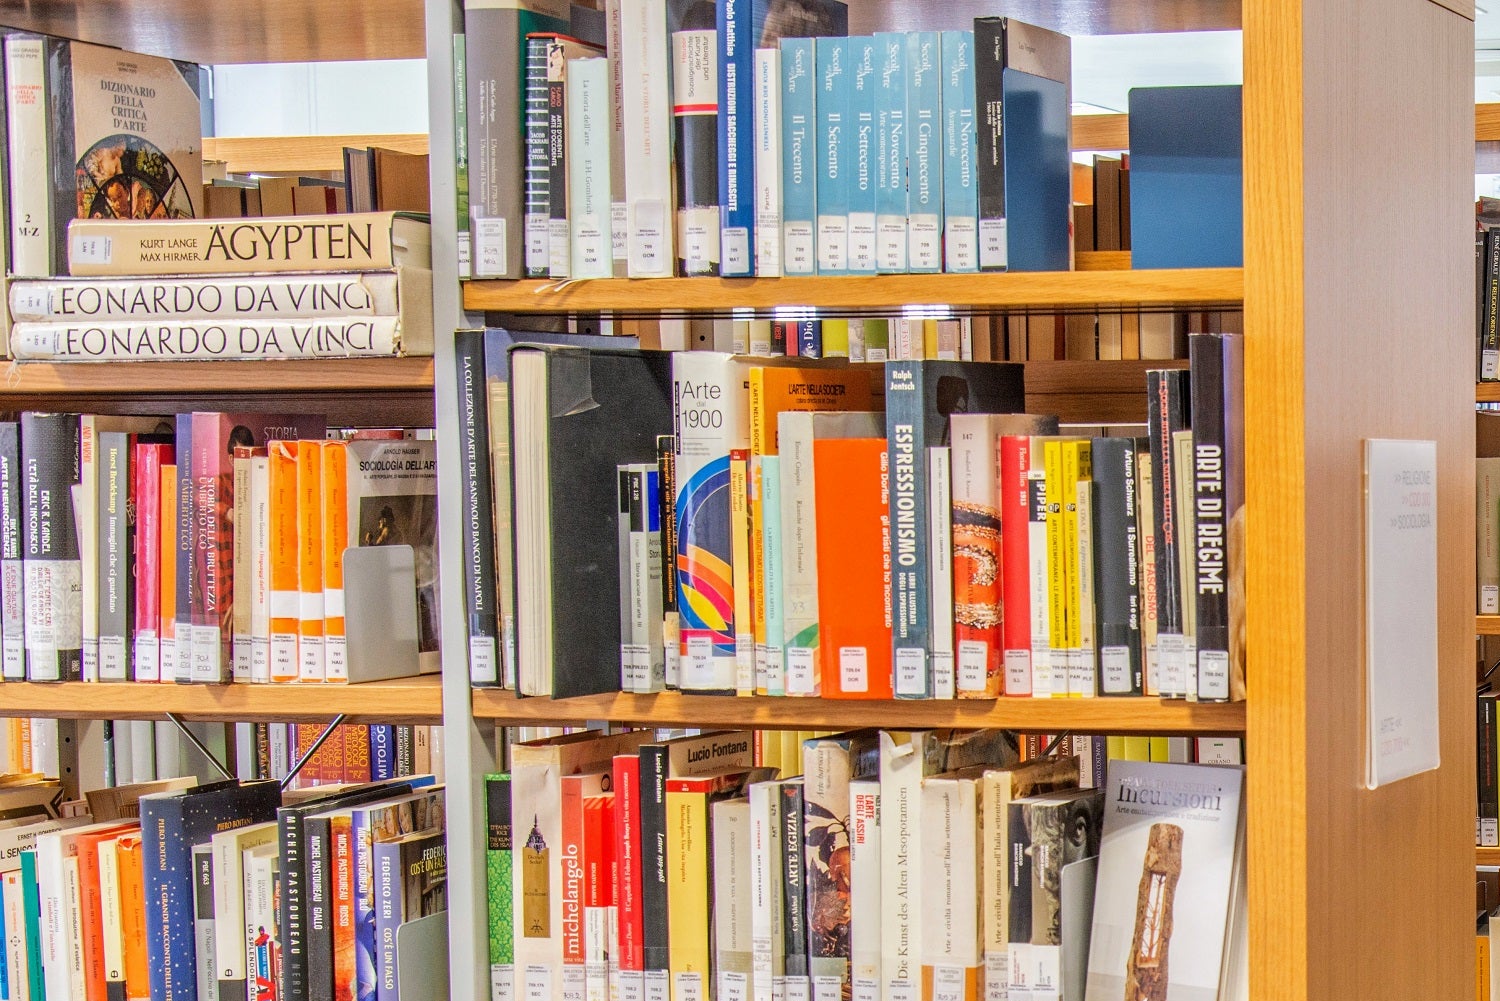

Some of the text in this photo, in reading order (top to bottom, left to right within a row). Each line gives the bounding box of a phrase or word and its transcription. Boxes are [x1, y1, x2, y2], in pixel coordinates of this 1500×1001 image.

[100, 80, 156, 98] DIZIONARIO
[114, 94, 144, 108] DELLA
[726, 63, 737, 113] DISTRUZIONI
[112, 107, 147, 121] CRITICA
[113, 120, 147, 132] D'ARTE
[726, 115, 737, 161] SACCHEGGI
[794, 126, 804, 183] Trecento
[829, 127, 840, 178] Seicento
[860, 126, 868, 190] Settecento
[920, 121, 930, 203] Cinquecento
[728, 169, 736, 211] RINASCITE
[140, 239, 198, 248] KURT LANGE
[140, 252, 201, 262] MAX HIRMER
[204, 223, 372, 261] ÄGYPTEN
[54, 283, 371, 314] EONARDO DA VINCI
[60, 322, 374, 356] EONARDO DA VINCI
[682, 381, 721, 399] Arte
[890, 382, 915, 391] Jentsch
[892, 371, 912, 380] Ralph
[682, 409, 723, 428] 1900
[359, 460, 404, 472] SOCIOLOGIA
[1125, 449, 1133, 477] Arturo
[464, 356, 483, 610] LA COLLEZIONE D'ARTE DEL SANPAOLO BANCO DI NAPOLI
[895, 425, 916, 566] ESPRESSIONISMO
[1126, 479, 1134, 516] Schwarz
[1037, 484, 1047, 521] PIPER
[1197, 444, 1223, 594] ARTE DI REGIME
[207, 477, 215, 611] STORIA DELLA BRUTTEZZA
[1127, 534, 1137, 586] Surrealismo
[1145, 536, 1156, 620] DEL FASCISMO
[688, 740, 747, 762] Lucio Fontana
[866, 795, 874, 819] L'ARTE
[1116, 781, 1222, 810] Incursioni
[856, 795, 864, 844] DEGLI ASSIRI
[202, 861, 210, 872] PBE
[788, 811, 799, 886] ARTE EGIZIA
[312, 836, 323, 929] MICHEL PASTOUREAU GIALLO
[338, 834, 349, 926] MICHEL PASTOUREAU ROSSO
[897, 787, 909, 979] Die Kunst des Alten Mesopotamien
[562, 844, 584, 955] michelangelo
[382, 856, 394, 989] FEDERICO ZERI COS'È UN FALSO
